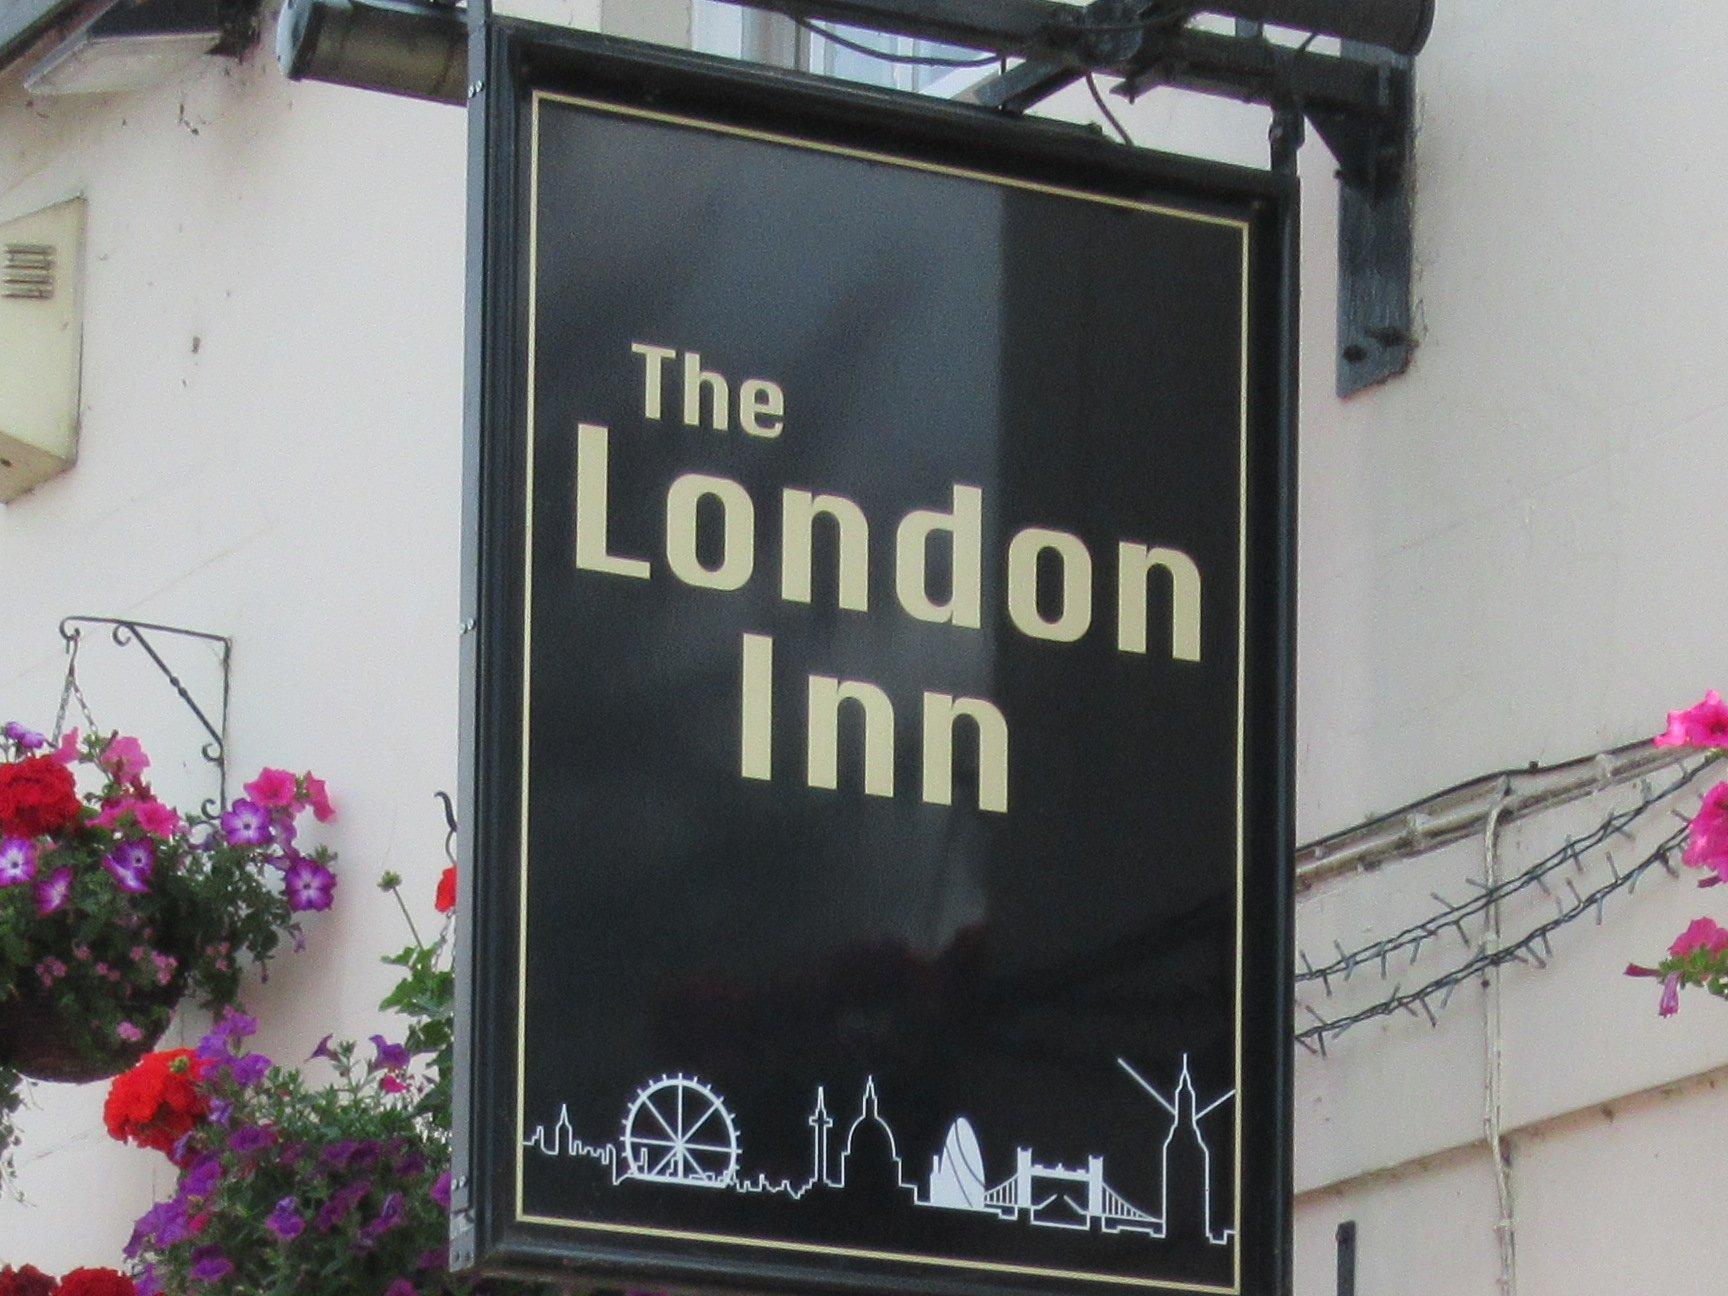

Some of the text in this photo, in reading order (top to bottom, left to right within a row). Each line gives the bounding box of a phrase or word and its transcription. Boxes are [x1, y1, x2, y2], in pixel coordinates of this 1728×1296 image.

[631, 343, 784, 438] The
[575, 424, 1201, 663] London
[739, 633, 1009, 814] Inn
